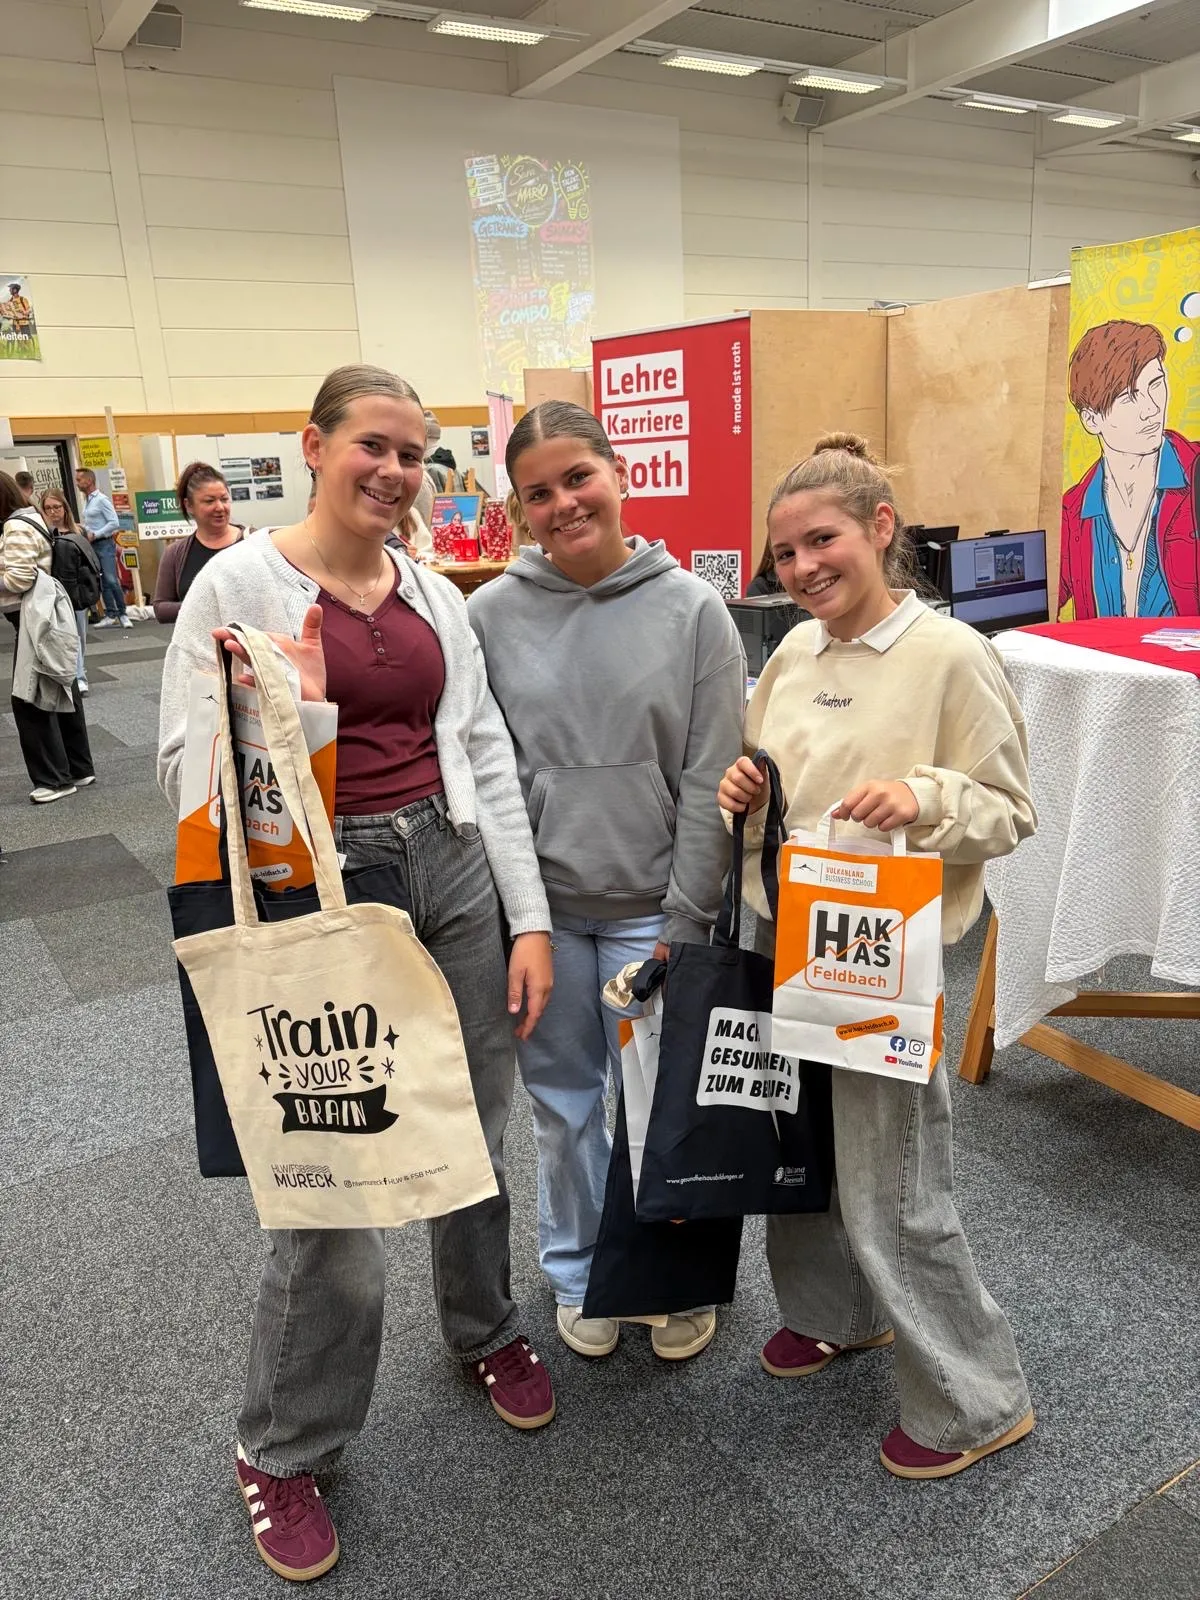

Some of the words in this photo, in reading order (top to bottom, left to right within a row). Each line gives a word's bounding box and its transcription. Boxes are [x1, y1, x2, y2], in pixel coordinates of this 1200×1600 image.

[500, 303, 550, 326] COMBO
[606, 363, 677, 396] Lehre
[607, 410, 683, 436] Karriere
[630, 450, 682, 489] oth
[812, 690, 853, 708] Whatever
[248, 786, 283, 814] AS
[825, 874, 851, 885] BUSINESS
[852, 878, 874, 888] SCHOOL
[826, 867, 865, 879] VULKANLAND
[813, 965, 888, 988] Feldbach
[246, 1001, 378, 1060] Train
[294, 1058, 352, 1089] YOUR
[705, 1074, 745, 1094] ZUM
[294, 1098, 367, 1127] BRAIN
[274, 1173, 337, 1188] MURECK
[425, 1163, 450, 1176] Mureck
